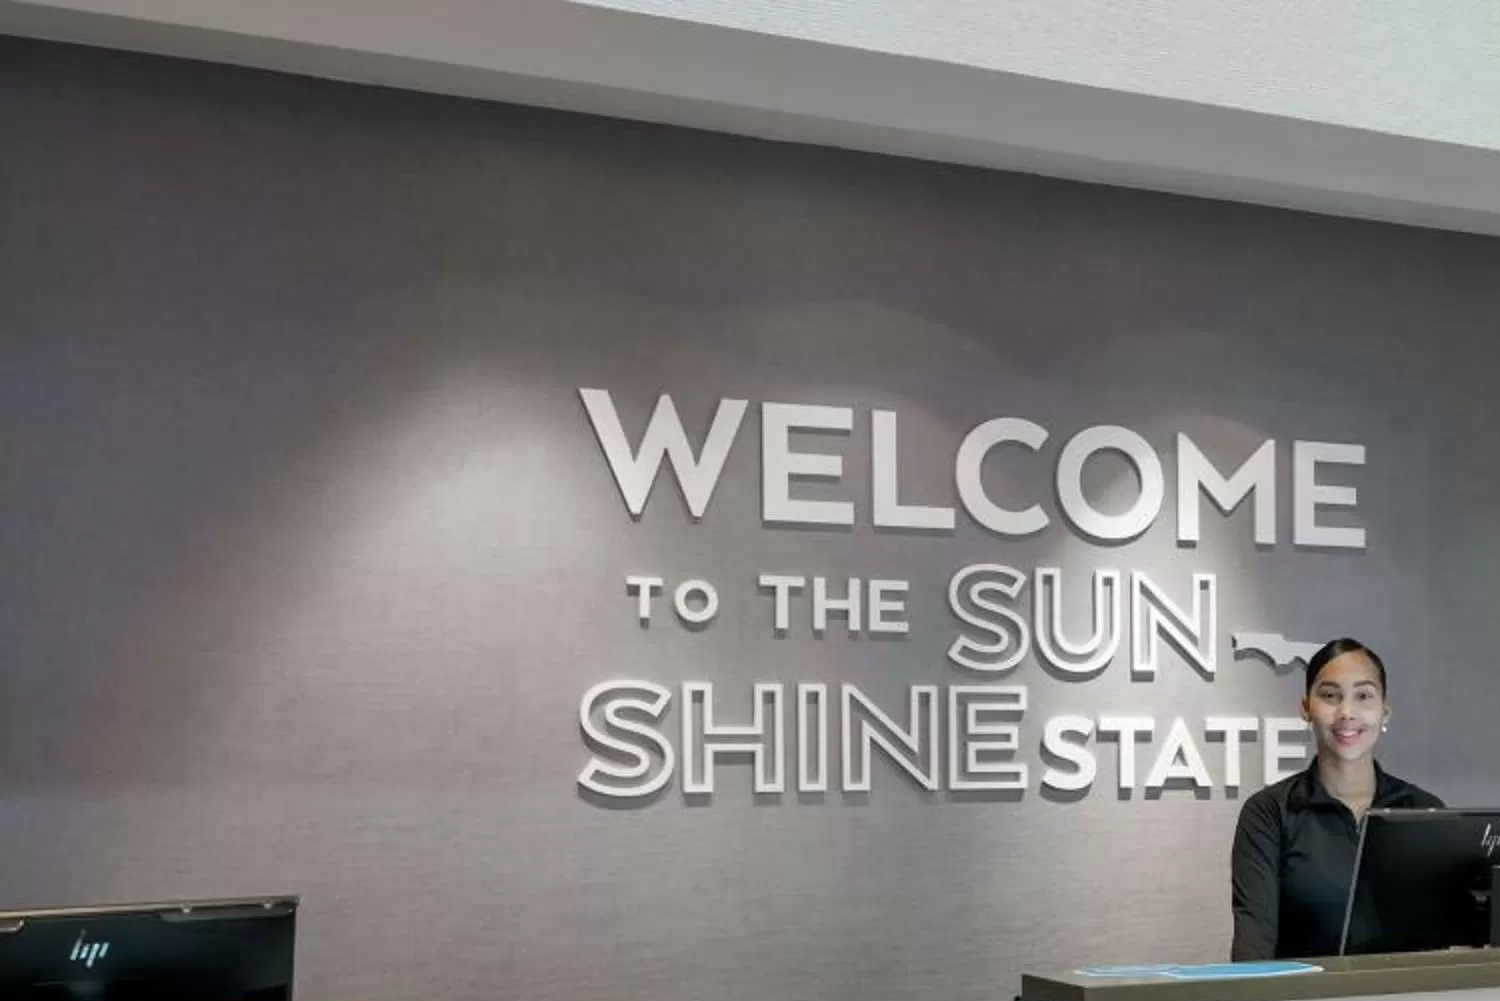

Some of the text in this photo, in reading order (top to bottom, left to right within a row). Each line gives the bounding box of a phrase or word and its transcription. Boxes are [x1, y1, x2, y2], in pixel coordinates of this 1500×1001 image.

[579, 388, 1366, 548] WELCOME
[626, 563, 1217, 673] TO THE SUN
[69, 927, 110, 969] hp
